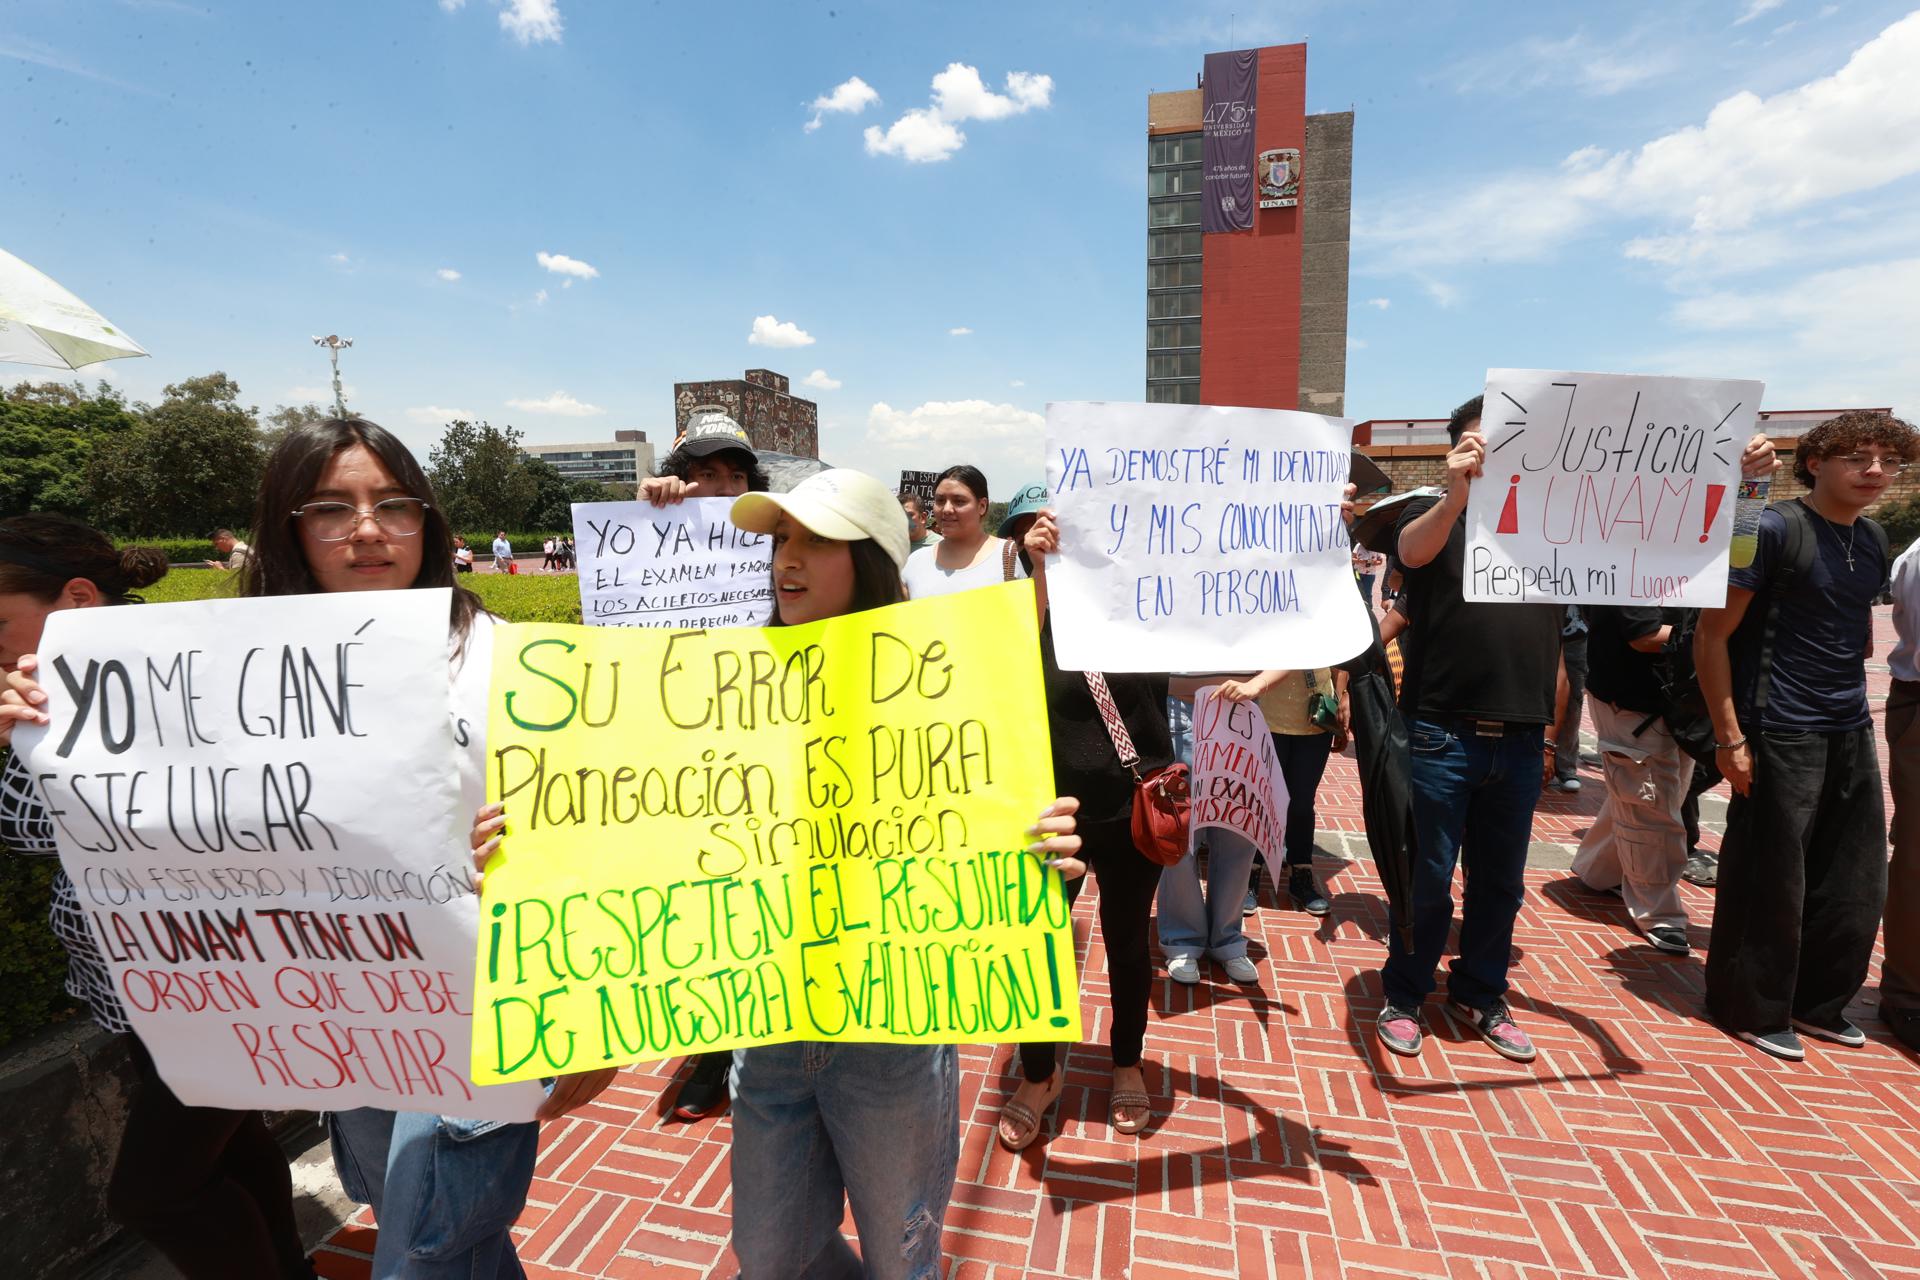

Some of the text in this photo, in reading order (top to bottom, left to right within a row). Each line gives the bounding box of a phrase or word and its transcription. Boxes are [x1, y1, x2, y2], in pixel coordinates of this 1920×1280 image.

[1203, 122, 1250, 131] UNIVERSIDAD
[695, 422, 738, 437] YORK
[1522, 383, 1704, 474] Justicia
[1056, 447, 1092, 494] YA
[1106, 439, 1229, 485] DEMOSTRÉ
[1243, 449, 1259, 483] MI
[587, 520, 635, 558] YO
[652, 521, 694, 558] YA
[1148, 503, 1202, 554] MIS
[594, 599, 628, 613] LOS
[720, 588, 775, 602] NECESAR
[596, 567, 628, 590] EL
[641, 563, 717, 586] EXAMEN
[1137, 569, 1299, 621] EN PERSONA
[1473, 547, 1688, 606] Respeta mi Lugar
[680, 615, 738, 628] DERECHO
[746, 611, 755, 621] A
[52, 618, 375, 758] YO ME GANÉ
[660, 628, 834, 730] ERROR
[1228, 702, 1256, 740] ES
[495, 719, 993, 834] Planeación ES PURA
[1194, 742, 1259, 784] XAMEN
[39, 761, 338, 853] ESTE LUGAR
[84, 864, 477, 905] CON ESFUERZO Y DEDICACIÓN
[93, 908, 424, 962] LA UNAM TIENE UN
[489, 850, 1068, 984] ¡RESPETEN EL RESULTADO
[123, 967, 473, 1015] ORDEN QUE DEBE
[491, 931, 1070, 1074] DE NUESTRA EVALUACIÓN!
[232, 1019, 472, 1100] RESPETAR
